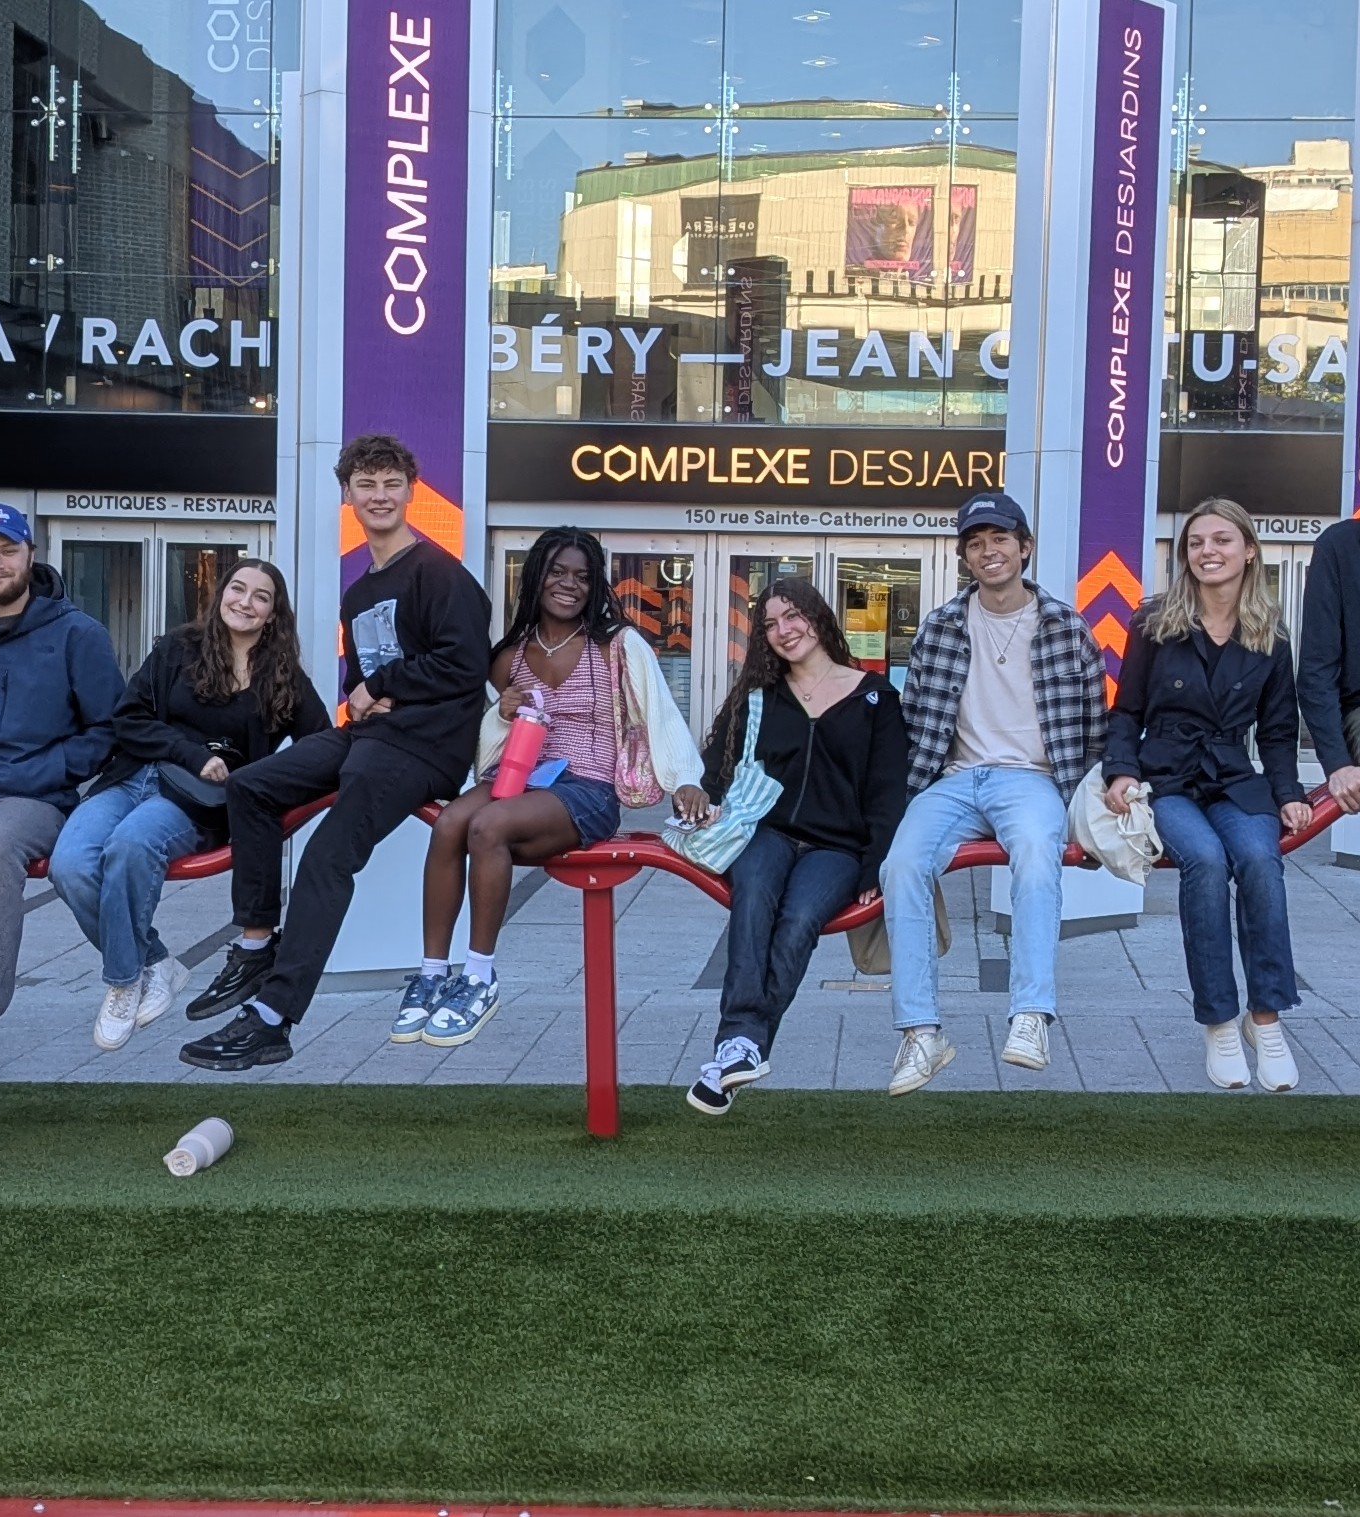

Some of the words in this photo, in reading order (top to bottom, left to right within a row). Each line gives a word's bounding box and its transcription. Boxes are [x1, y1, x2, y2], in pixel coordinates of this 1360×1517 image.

[1115, 26, 1143, 255] DESJARDINS
[384, 12, 432, 335] COMPLEXE
[762, 328, 954, 378] JEAN
[1106, 267, 1132, 468] COMPLEXE
[571, 443, 811, 485] COMPLEXE
[828, 449, 1006, 488] DESJAR
[66, 495, 167, 511] BOUTIQUES
[183, 497, 276, 514] RESTAURA
[685, 509, 716, 525] 150
[721, 512, 749, 525] rue
[754, 510, 907, 528] Sainte-Catherine
